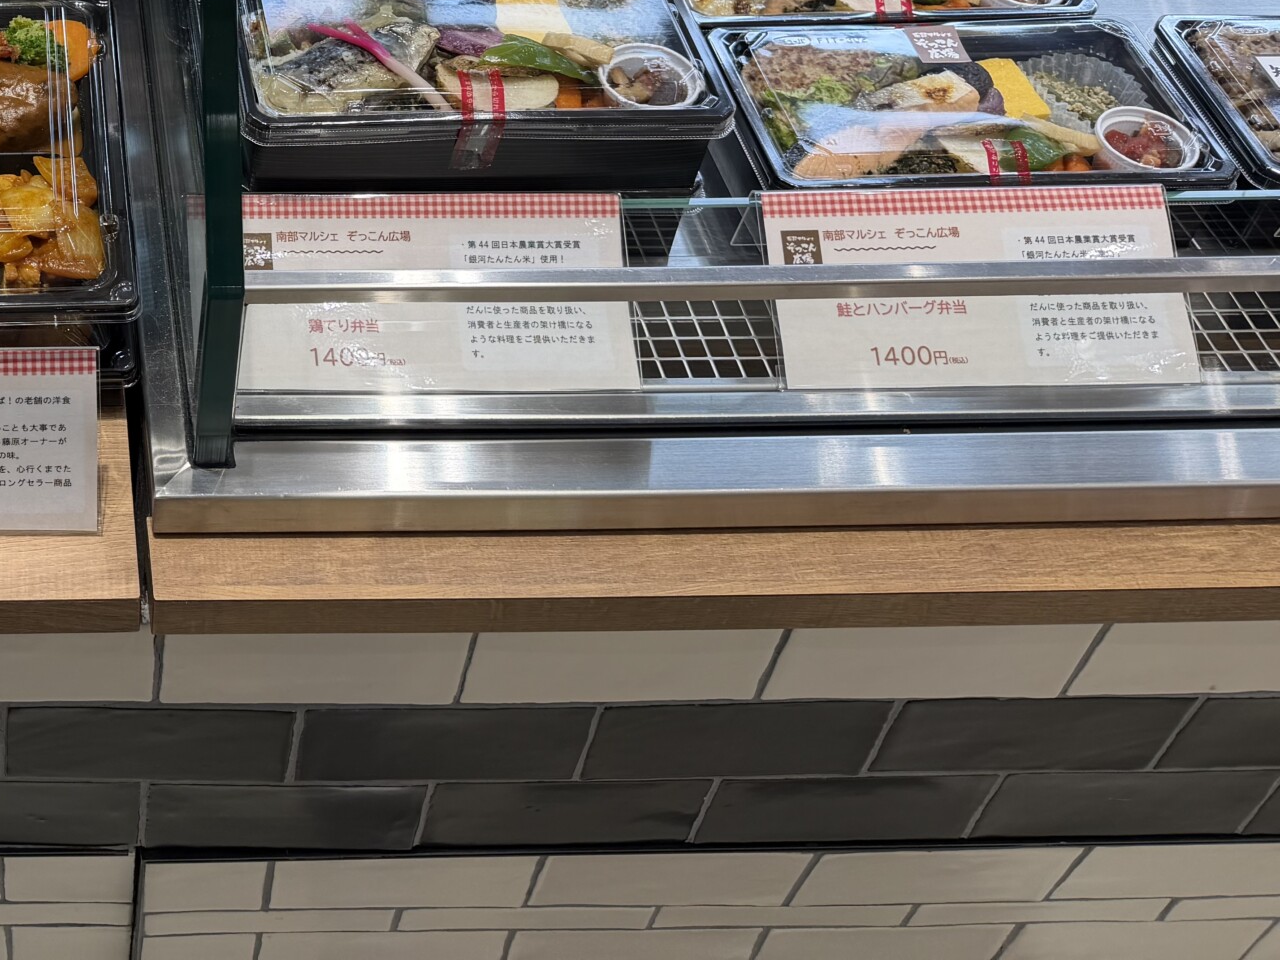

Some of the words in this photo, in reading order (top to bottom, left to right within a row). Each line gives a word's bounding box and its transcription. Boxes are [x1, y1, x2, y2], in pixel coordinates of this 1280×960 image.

[276, 230, 338, 243] 南部マルシェ
[347, 230, 411, 242] ぞっこん広場
[822, 229, 886, 241] 南部マルシェ
[894, 227, 960, 239] ぞっこん広場
[462, 254, 565, 265] 「銀河たんたん米」使用！
[466, 305, 587, 316] だんに使った商品を取り扱い、
[837, 299, 967, 318] 鮭とハンバーグ弁当
[1029, 300, 1149, 311] だんに使った商品を取り扱い、
[309, 318, 380, 333] 鶏てり弁当
[467, 319, 593, 331] 消費者と生産者の架け橋になる
[1032, 315, 1156, 327] 消費者と生産者の架け橋になる
[470, 334, 596, 345] ような料理をご提供いただきま
[471, 348, 485, 359] す。
[1037, 347, 1050, 357] す。
